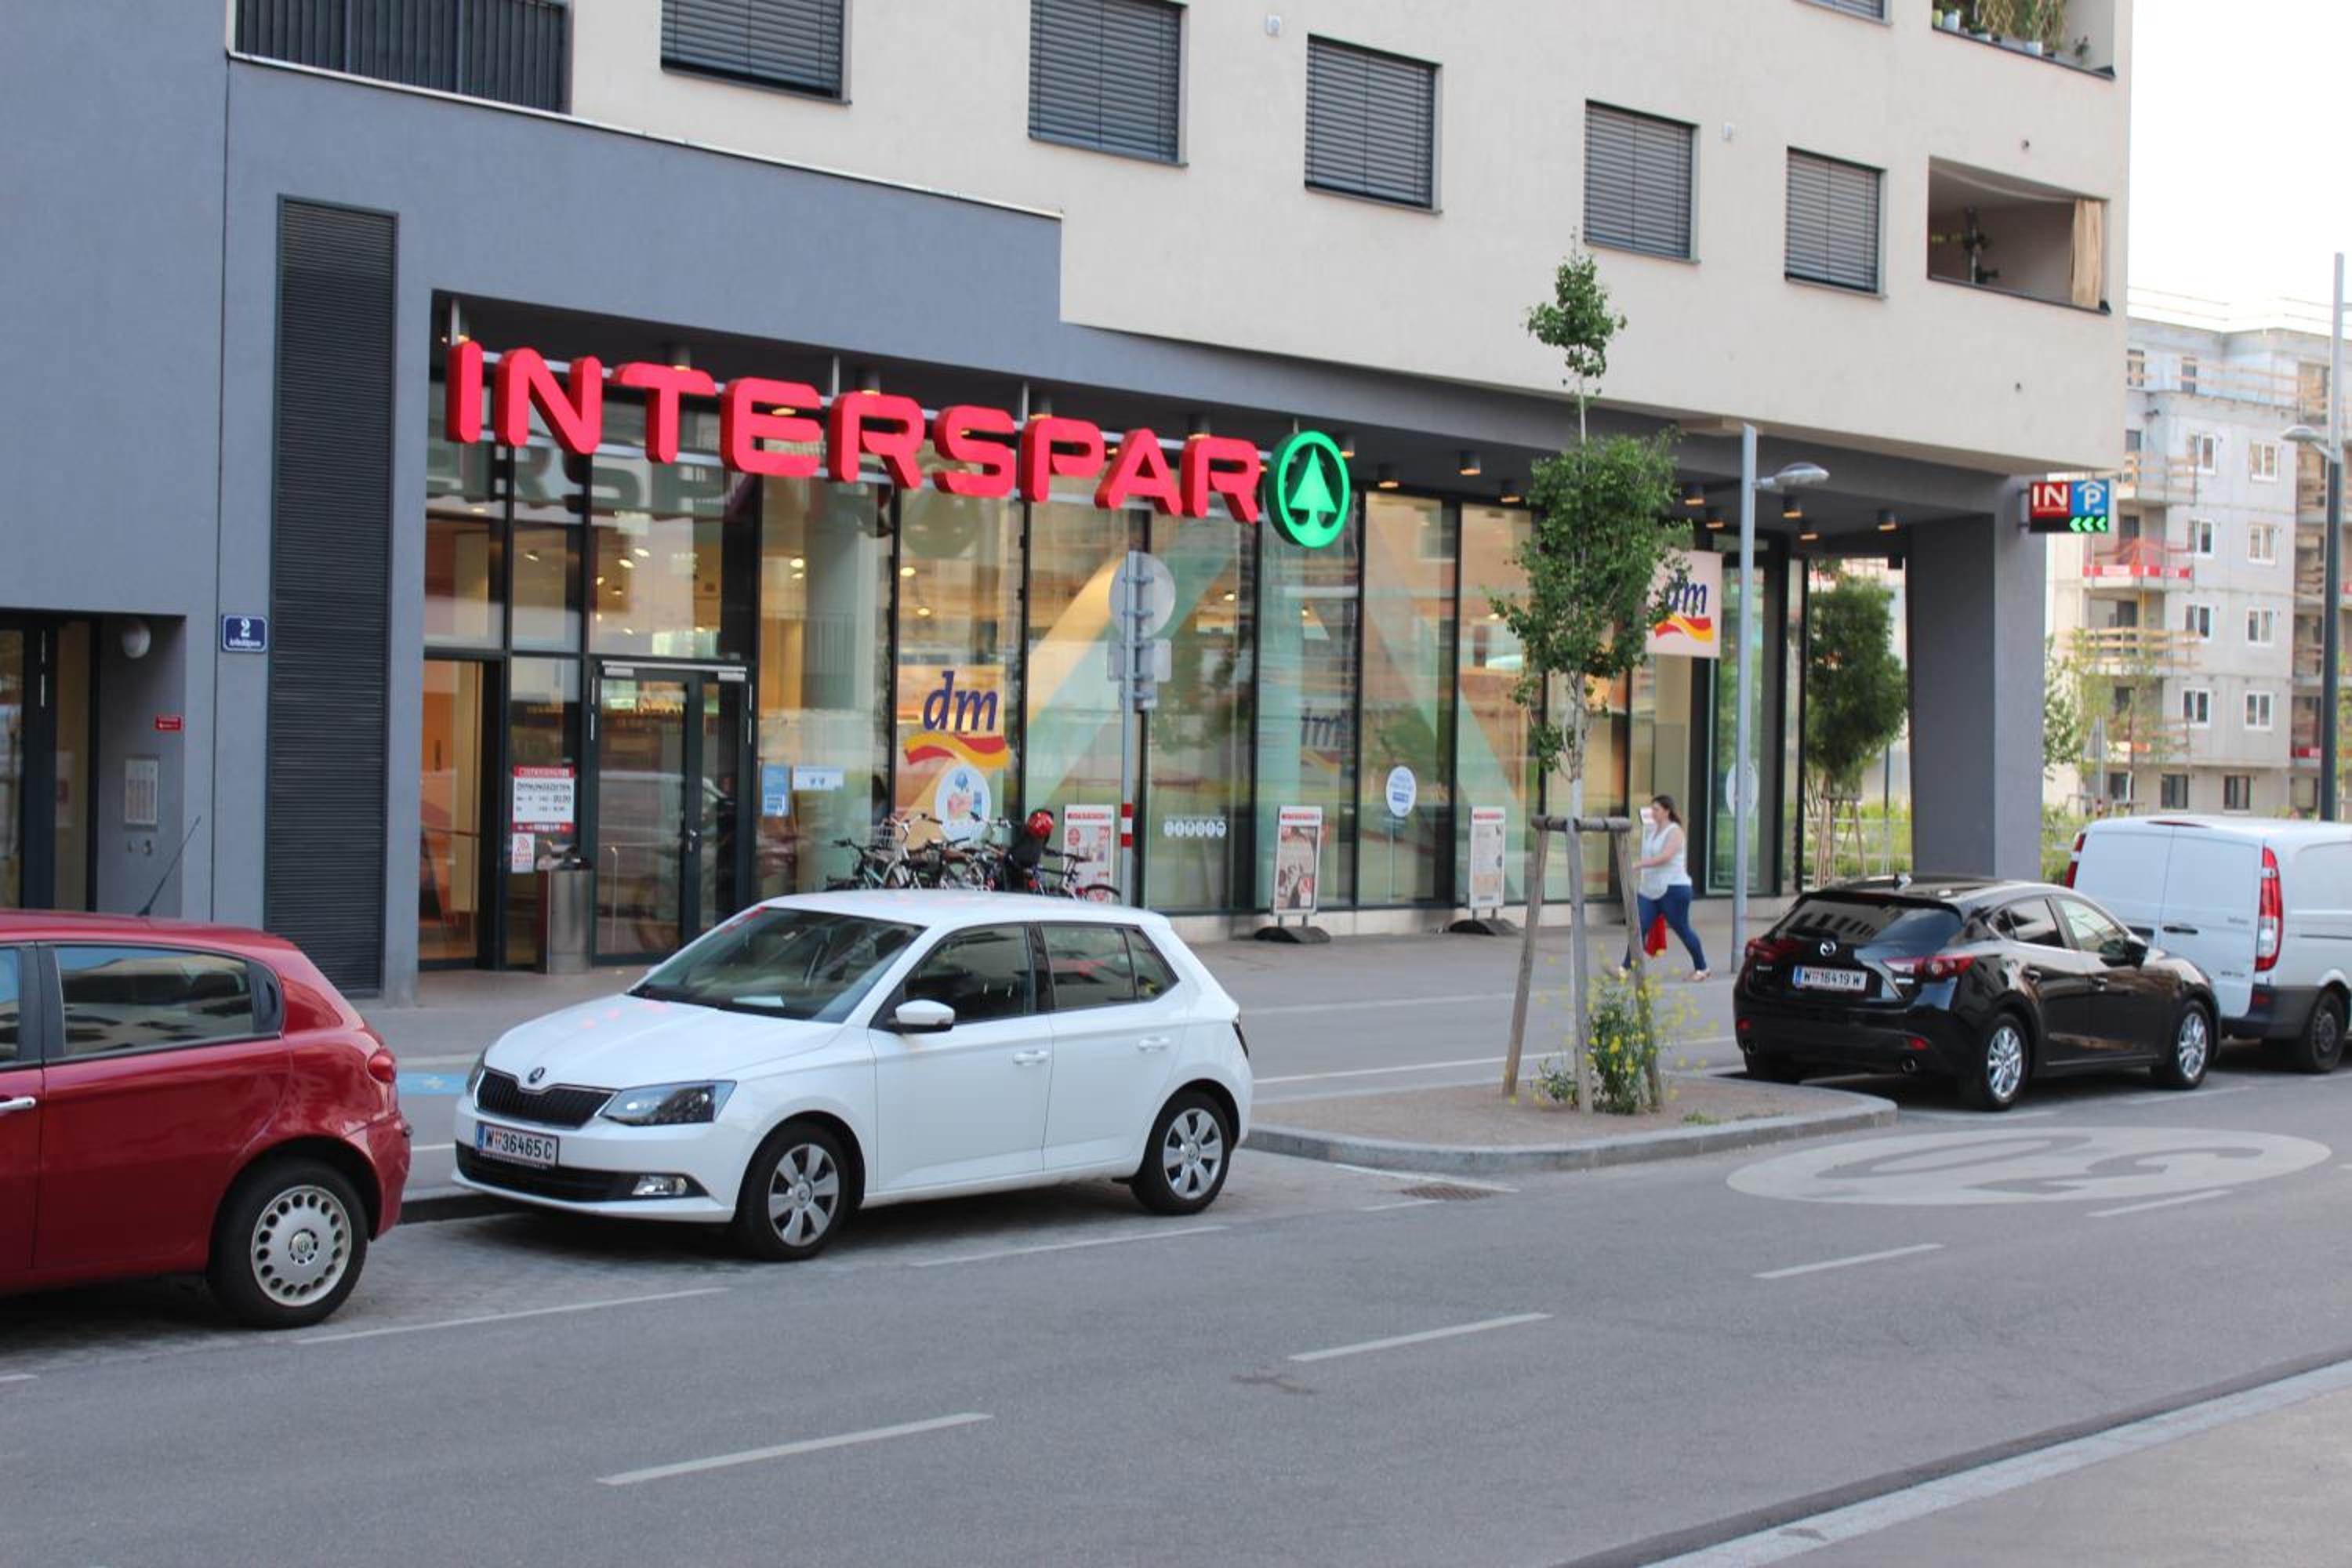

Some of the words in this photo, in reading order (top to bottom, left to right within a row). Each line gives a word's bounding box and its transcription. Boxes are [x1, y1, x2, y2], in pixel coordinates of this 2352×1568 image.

[445, 340, 1261, 524] INTERSPAR
[2033, 485, 2067, 506] IN
[2084, 488, 2101, 511] P
[1664, 568, 1707, 615] dm
[241, 617, 251, 638] 2
[922, 670, 998, 731] dm
[485, 1131, 495, 1148] W
[502, 1133, 543, 1158] 36465
